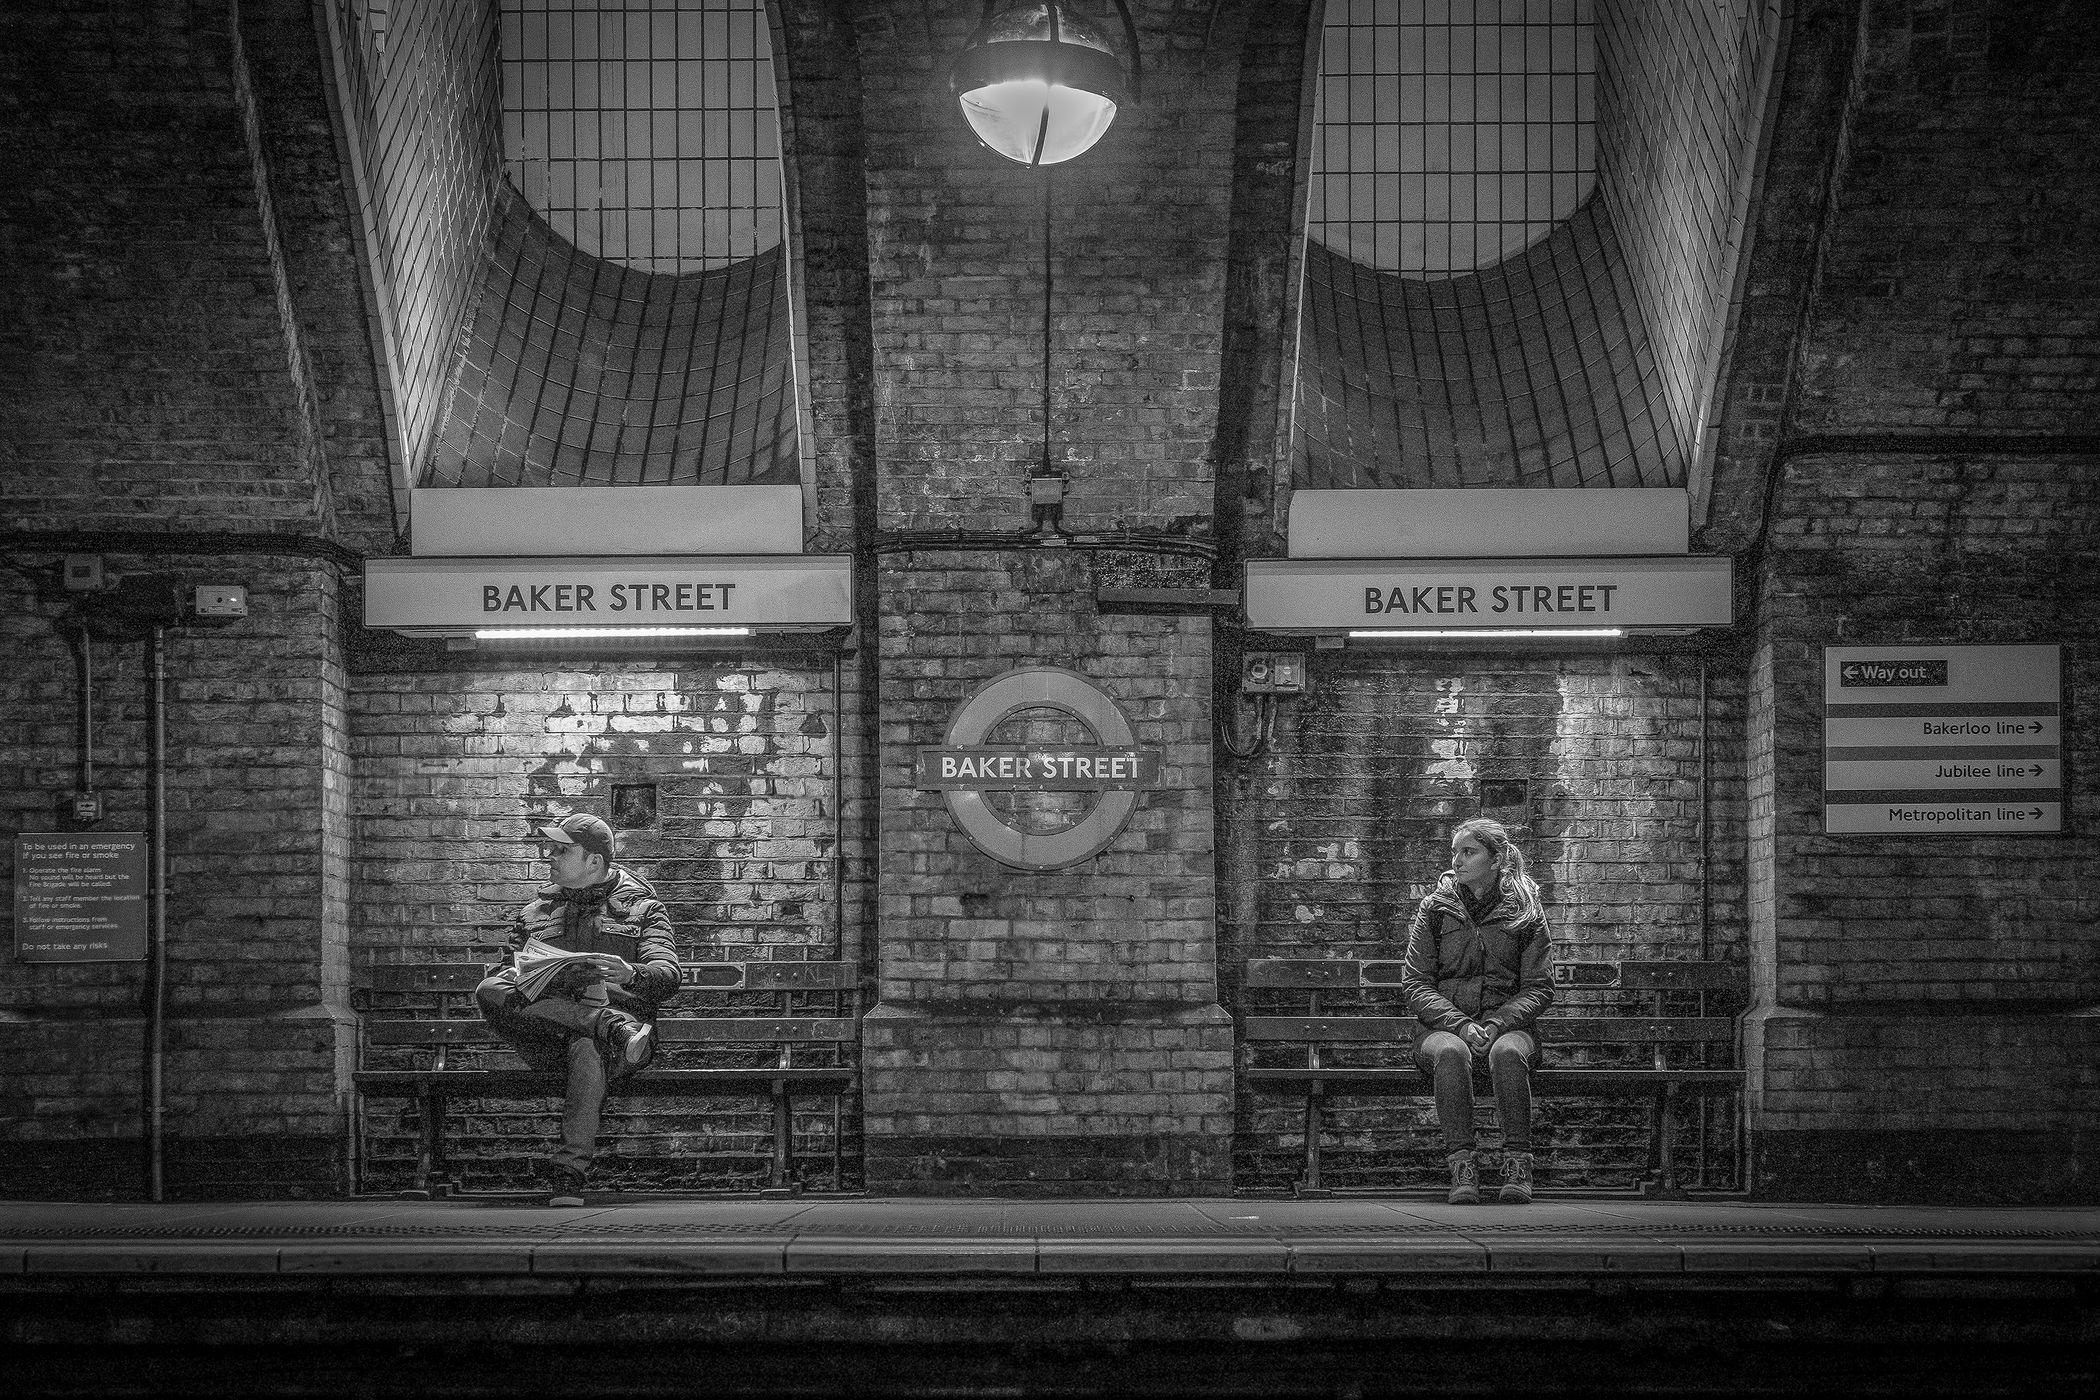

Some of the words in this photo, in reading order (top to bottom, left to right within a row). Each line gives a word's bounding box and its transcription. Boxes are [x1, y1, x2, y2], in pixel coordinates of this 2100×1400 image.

[483, 585, 597, 612] BAKER
[609, 583, 736, 612] STREET
[1365, 587, 1478, 614] BAKER
[1491, 585, 1617, 613] STREET
[1861, 665, 1896, 682] Way
[1899, 666, 1927, 679] out
[1923, 722, 1991, 735] Bakerloo
[1997, 721, 2025, 735] line
[942, 757, 1032, 778] BAKER
[1042, 757, 1143, 779] STREET
[1935, 765, 1991, 778] Jubilee
[1997, 765, 2025, 777] line
[1889, 808, 1991, 824] Metropolitan
[1997, 808, 2025, 821] line
[91, 843, 136, 851] emergency
[43, 881, 66, 889] Brigade
